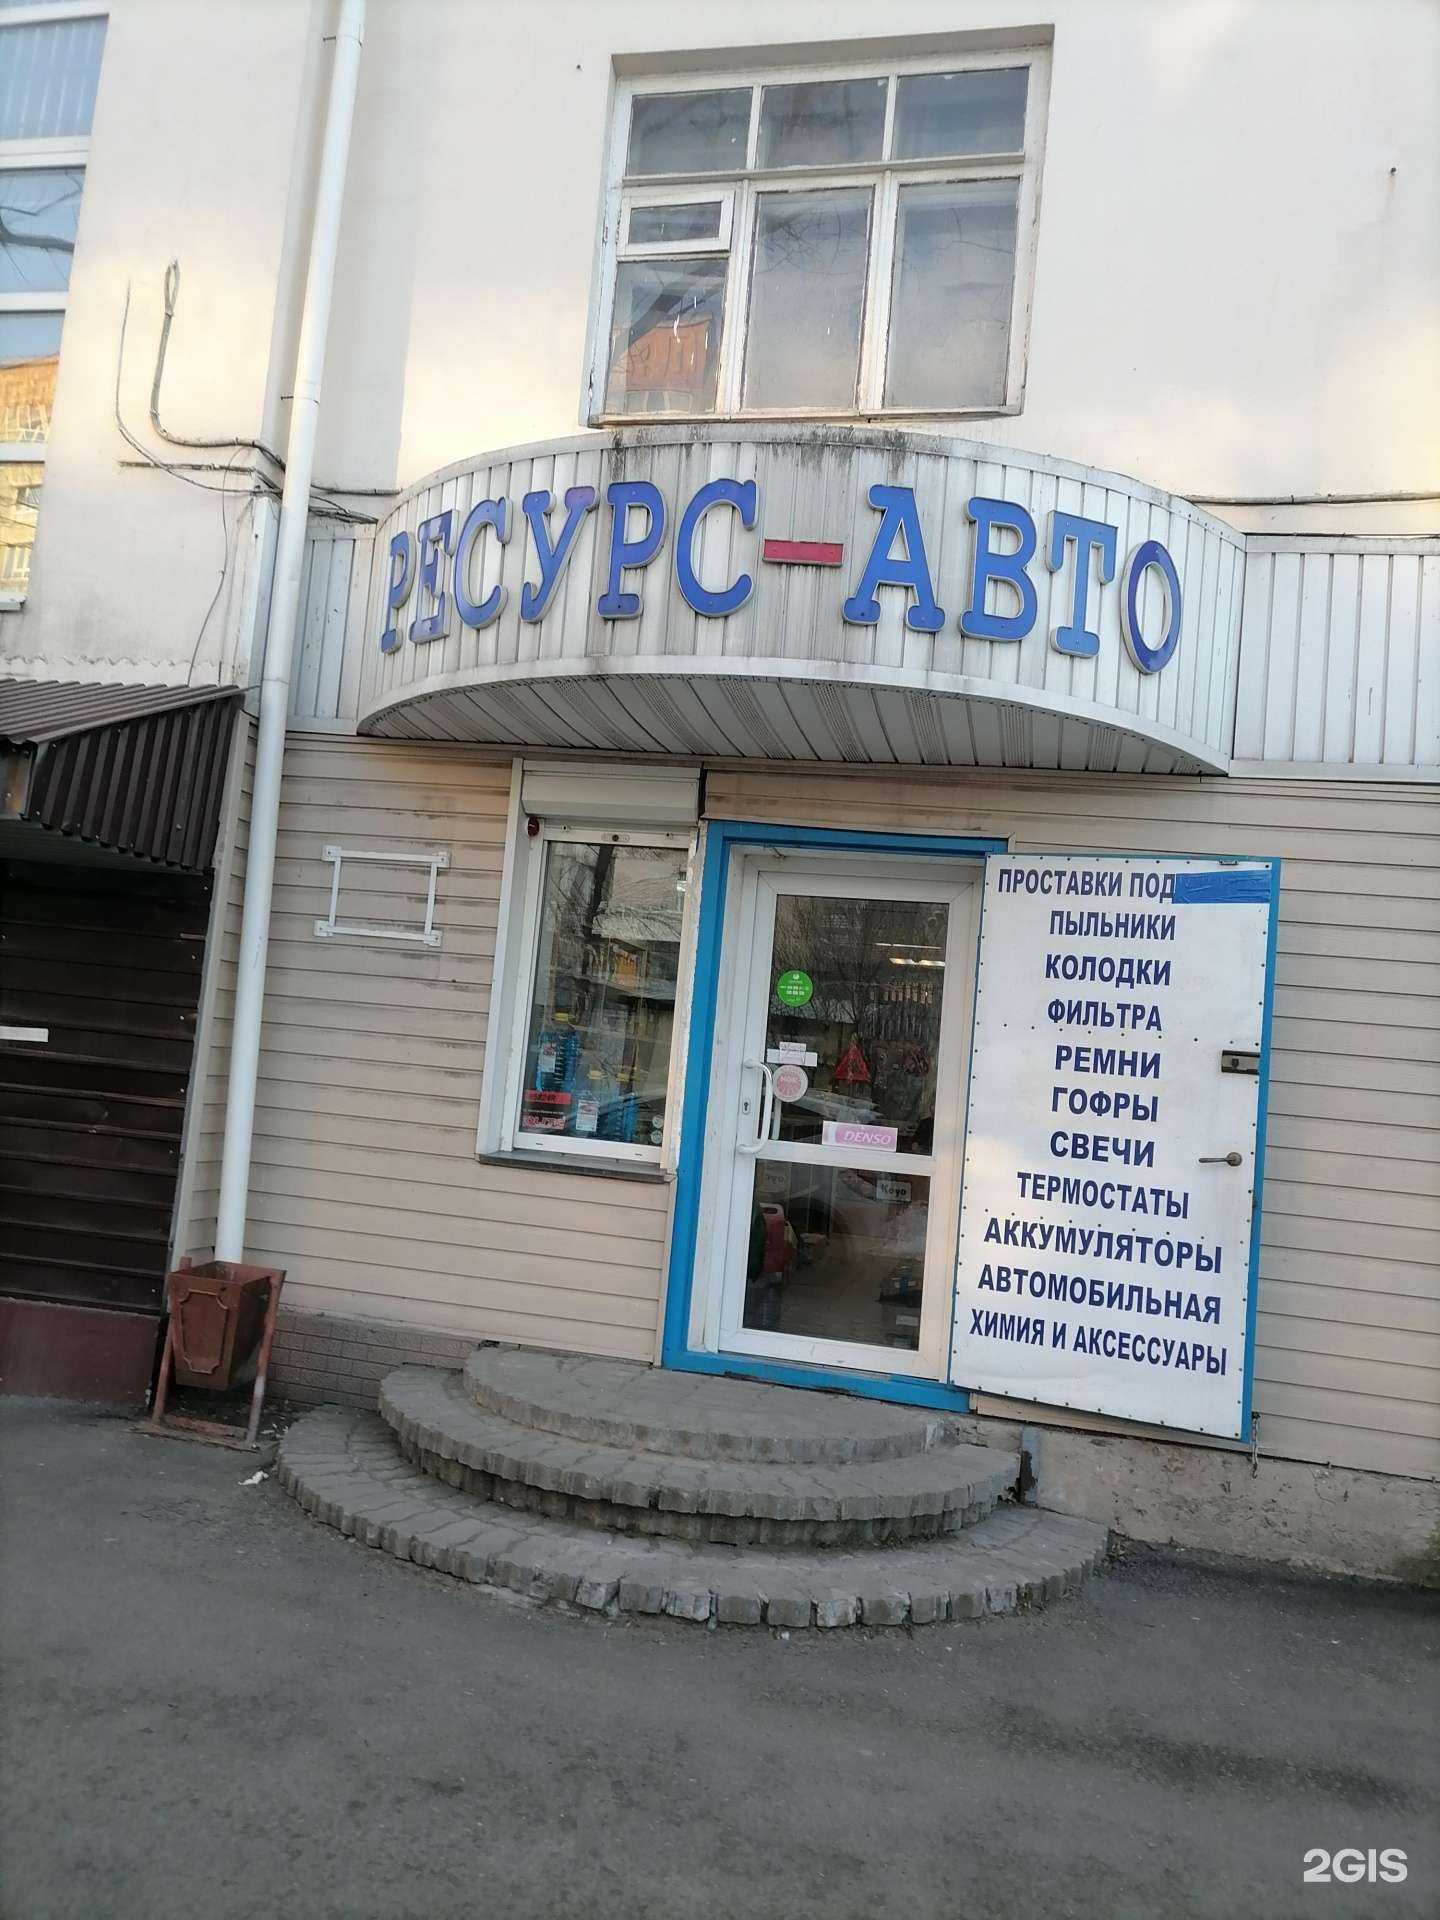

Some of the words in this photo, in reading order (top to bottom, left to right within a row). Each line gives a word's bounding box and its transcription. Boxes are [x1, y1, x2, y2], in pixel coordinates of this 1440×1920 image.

[380, 478, 1184, 675] РЕСУРС-АВТО
[998, 868, 1123, 897] ПРОСТАВКИ
[1129, 872, 1176, 903] ПОД
[1050, 910, 1176, 940] ПЫЛЬНИКИ
[1045, 954, 1172, 989] КОЛОДКИ
[1047, 999, 1162, 1031] ФИЛЬТРА
[1055, 1045, 1161, 1079] РЕМНИ
[1051, 1087, 1159, 1122] ГОФРЫ
[844, 1131, 892, 1145] DENSO
[1050, 1131, 1155, 1168] СВЕЧИ
[1017, 1171, 1189, 1219] ТЕРМОСТАТЫ
[984, 1217, 1222, 1274] АККУМУЛЯТОРЫ
[978, 1264, 1221, 1324] АВТОМОБИЛЬНАЯ
[969, 1309, 1045, 1345] ХИМИЯ
[1052, 1321, 1067, 1350] И
[1073, 1325, 1228, 1375] АКСЕССУАРЫ
